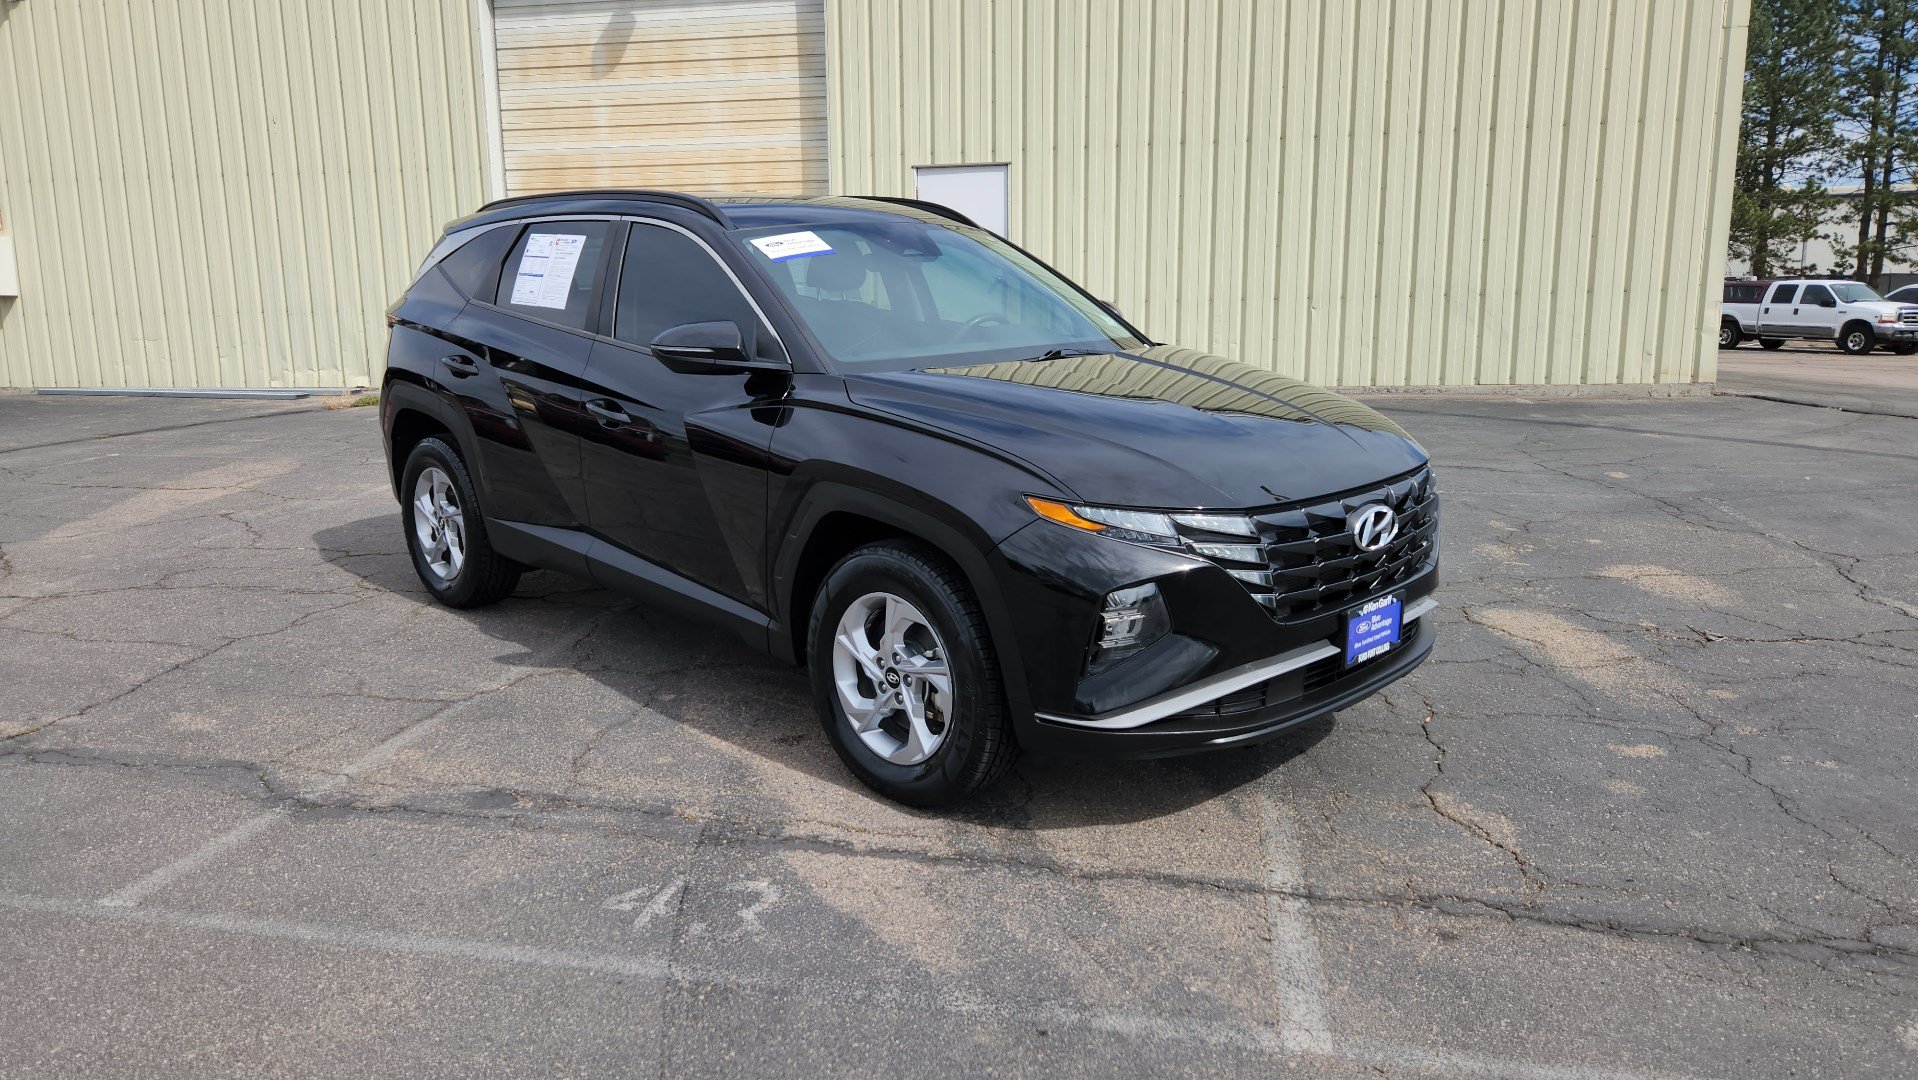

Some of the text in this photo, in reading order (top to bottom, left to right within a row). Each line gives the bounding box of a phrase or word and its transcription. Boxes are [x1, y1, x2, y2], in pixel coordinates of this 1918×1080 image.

[1371, 618, 1392, 631] Advantage
[1372, 615, 1381, 623] Blue
[1358, 652, 1368, 663] FORD
